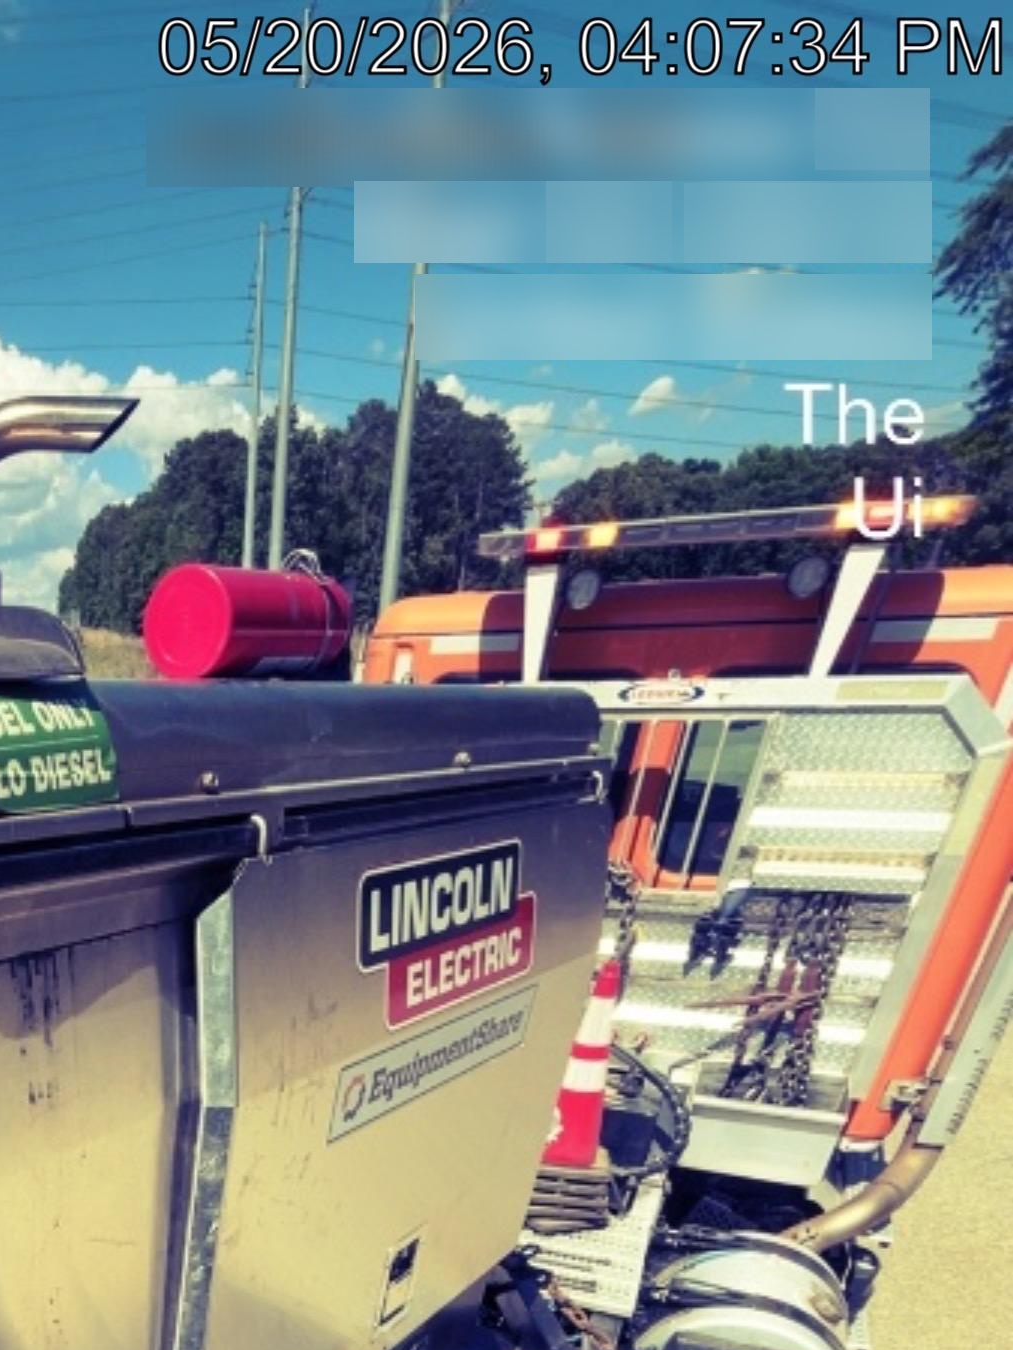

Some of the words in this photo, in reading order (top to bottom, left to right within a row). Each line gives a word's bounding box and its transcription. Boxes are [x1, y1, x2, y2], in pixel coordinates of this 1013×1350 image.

[33, 701, 97, 732] ONLY
[30, 746, 112, 794] DIESEL
[369, 856, 514, 955] LINCOLN
[406, 926, 523, 1009] ELECTRIC
[367, 1009, 525, 1103] EquipmentShare
